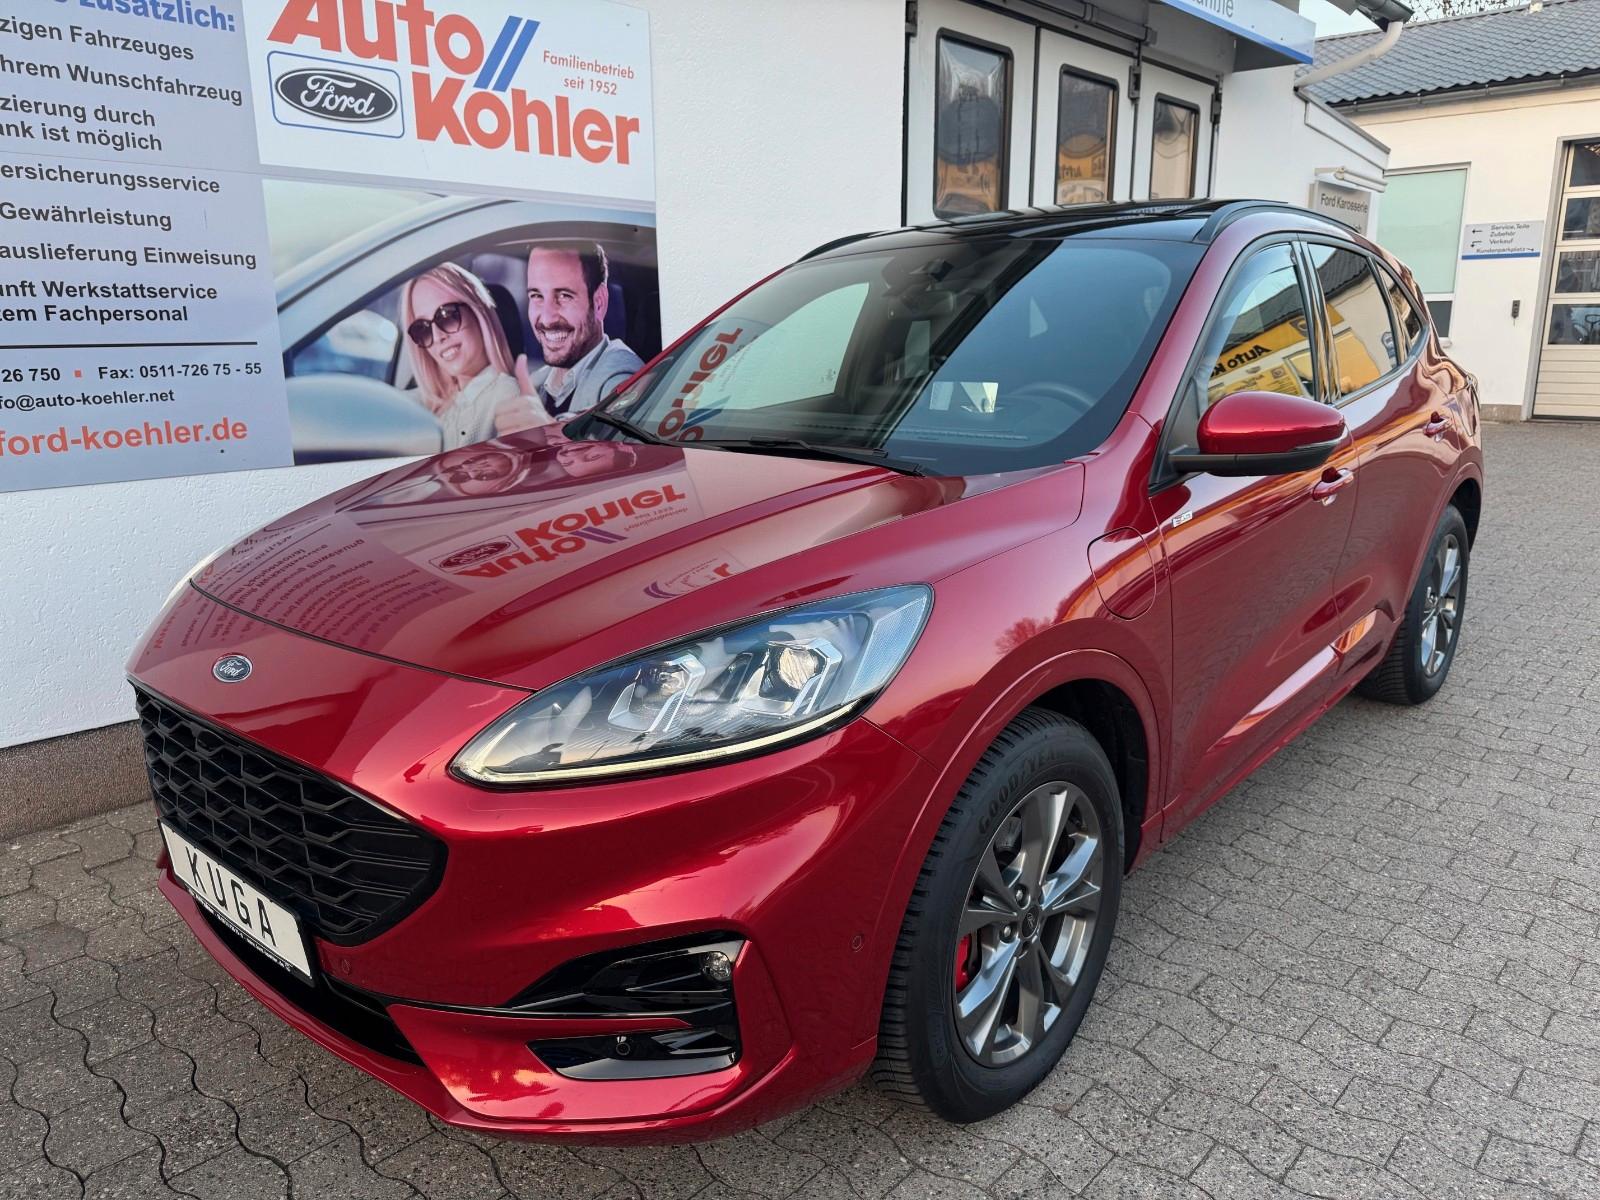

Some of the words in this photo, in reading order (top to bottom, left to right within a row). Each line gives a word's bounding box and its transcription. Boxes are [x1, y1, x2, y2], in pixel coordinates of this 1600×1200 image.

[0, 16, 63, 41] zigen
[69, 25, 195, 60] Fahrzeuges
[267, 0, 485, 75] Auto
[543, 50, 635, 80] Familienbetrieb
[67, 63, 243, 106] Wunschfahrzeug
[299, 73, 376, 117] Ford
[563, 77, 585, 90] seit
[590, 79, 618, 96] 1952
[0, 94, 87, 123] zierung
[93, 105, 156, 127] durch
[41, 122, 71, 143] ist
[77, 129, 162, 151] möglich
[1, 163, 221, 193] ersicherungsservice
[1320, 193, 1336, 207] Ford
[0, 201, 172, 232] Gewährleistung
[0, 243, 138, 266] auslieferung
[143, 247, 257, 270] Einweisung
[42, 281, 218, 300] Werkstattservice
[44, 304, 189, 325] Fachpersonal
[1, 368, 24, 383] 26
[28, 367, 61, 381] 750
[98, 366, 134, 380] Fax:
[139, 364, 210, 378] 0511-726
[213, 363, 231, 377] 75
[245, 362, 262, 375] 55
[219, 659, 245, 678] Ford
[184, 846, 277, 948] KUGA
